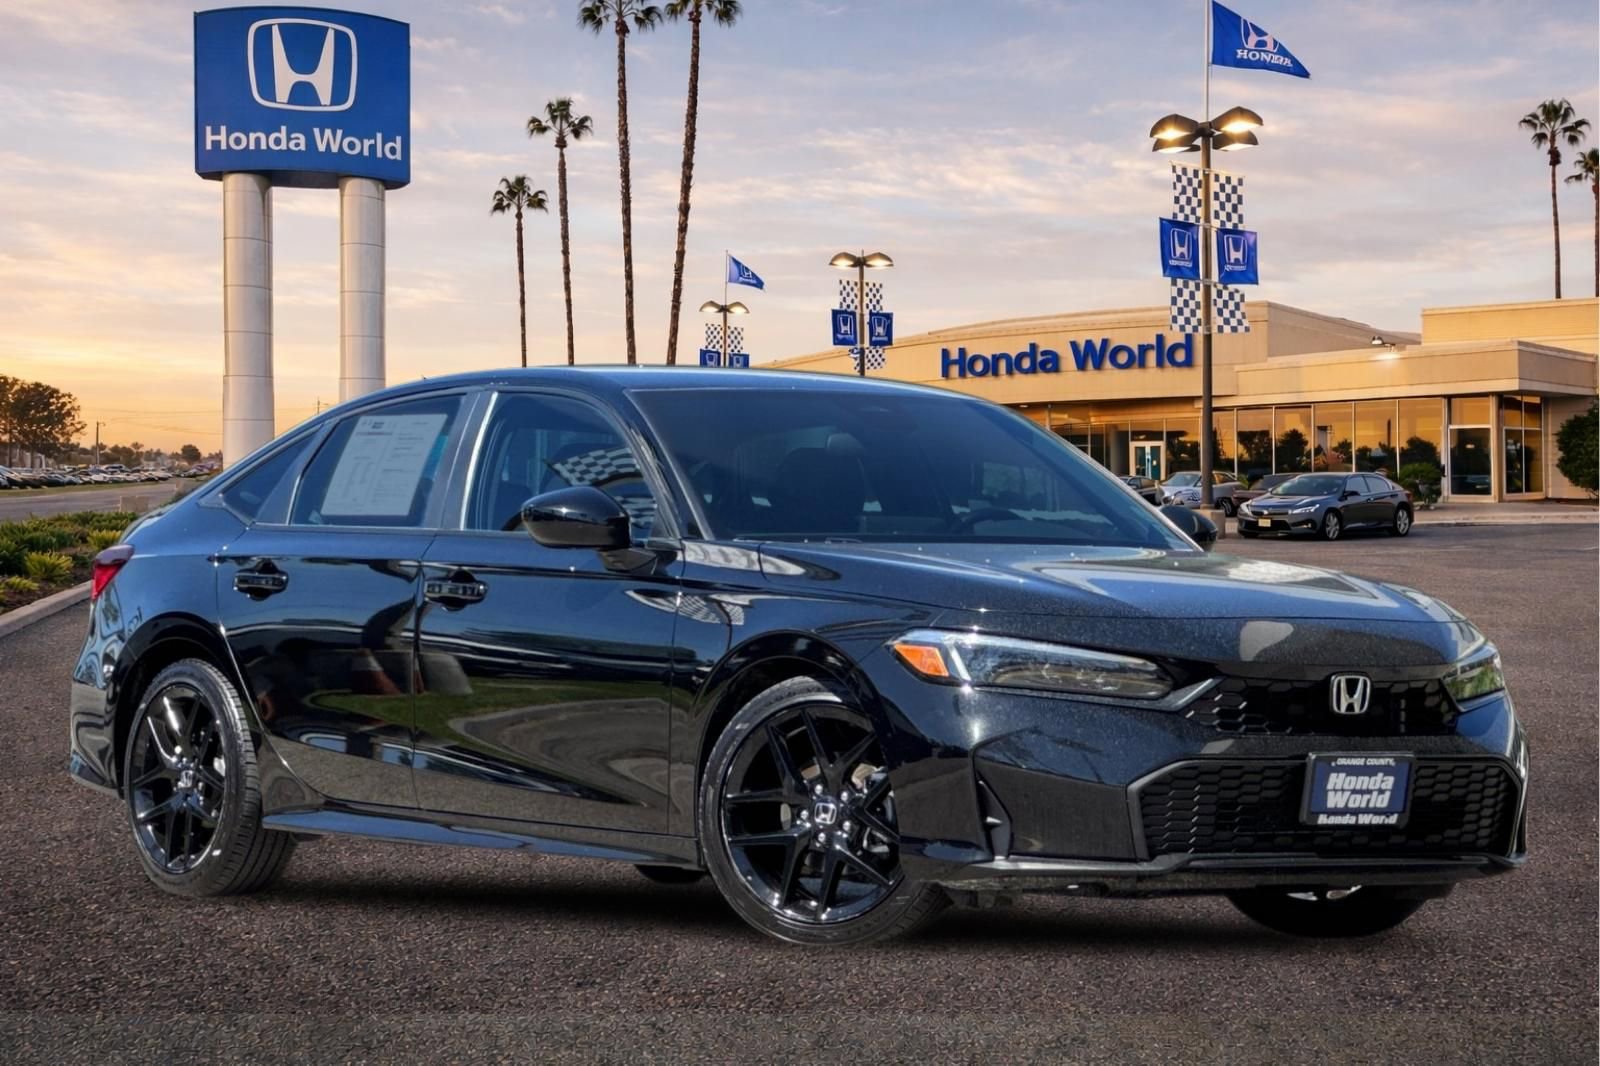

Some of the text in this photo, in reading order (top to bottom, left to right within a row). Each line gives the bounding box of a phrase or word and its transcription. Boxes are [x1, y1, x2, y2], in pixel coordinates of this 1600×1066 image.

[205, 125, 402, 161] Honda World
[941, 333, 1194, 378] Honda World
[1326, 772, 1395, 790] Honda
[1326, 790, 1391, 808] World
[1317, 813, 1357, 824] Honda
